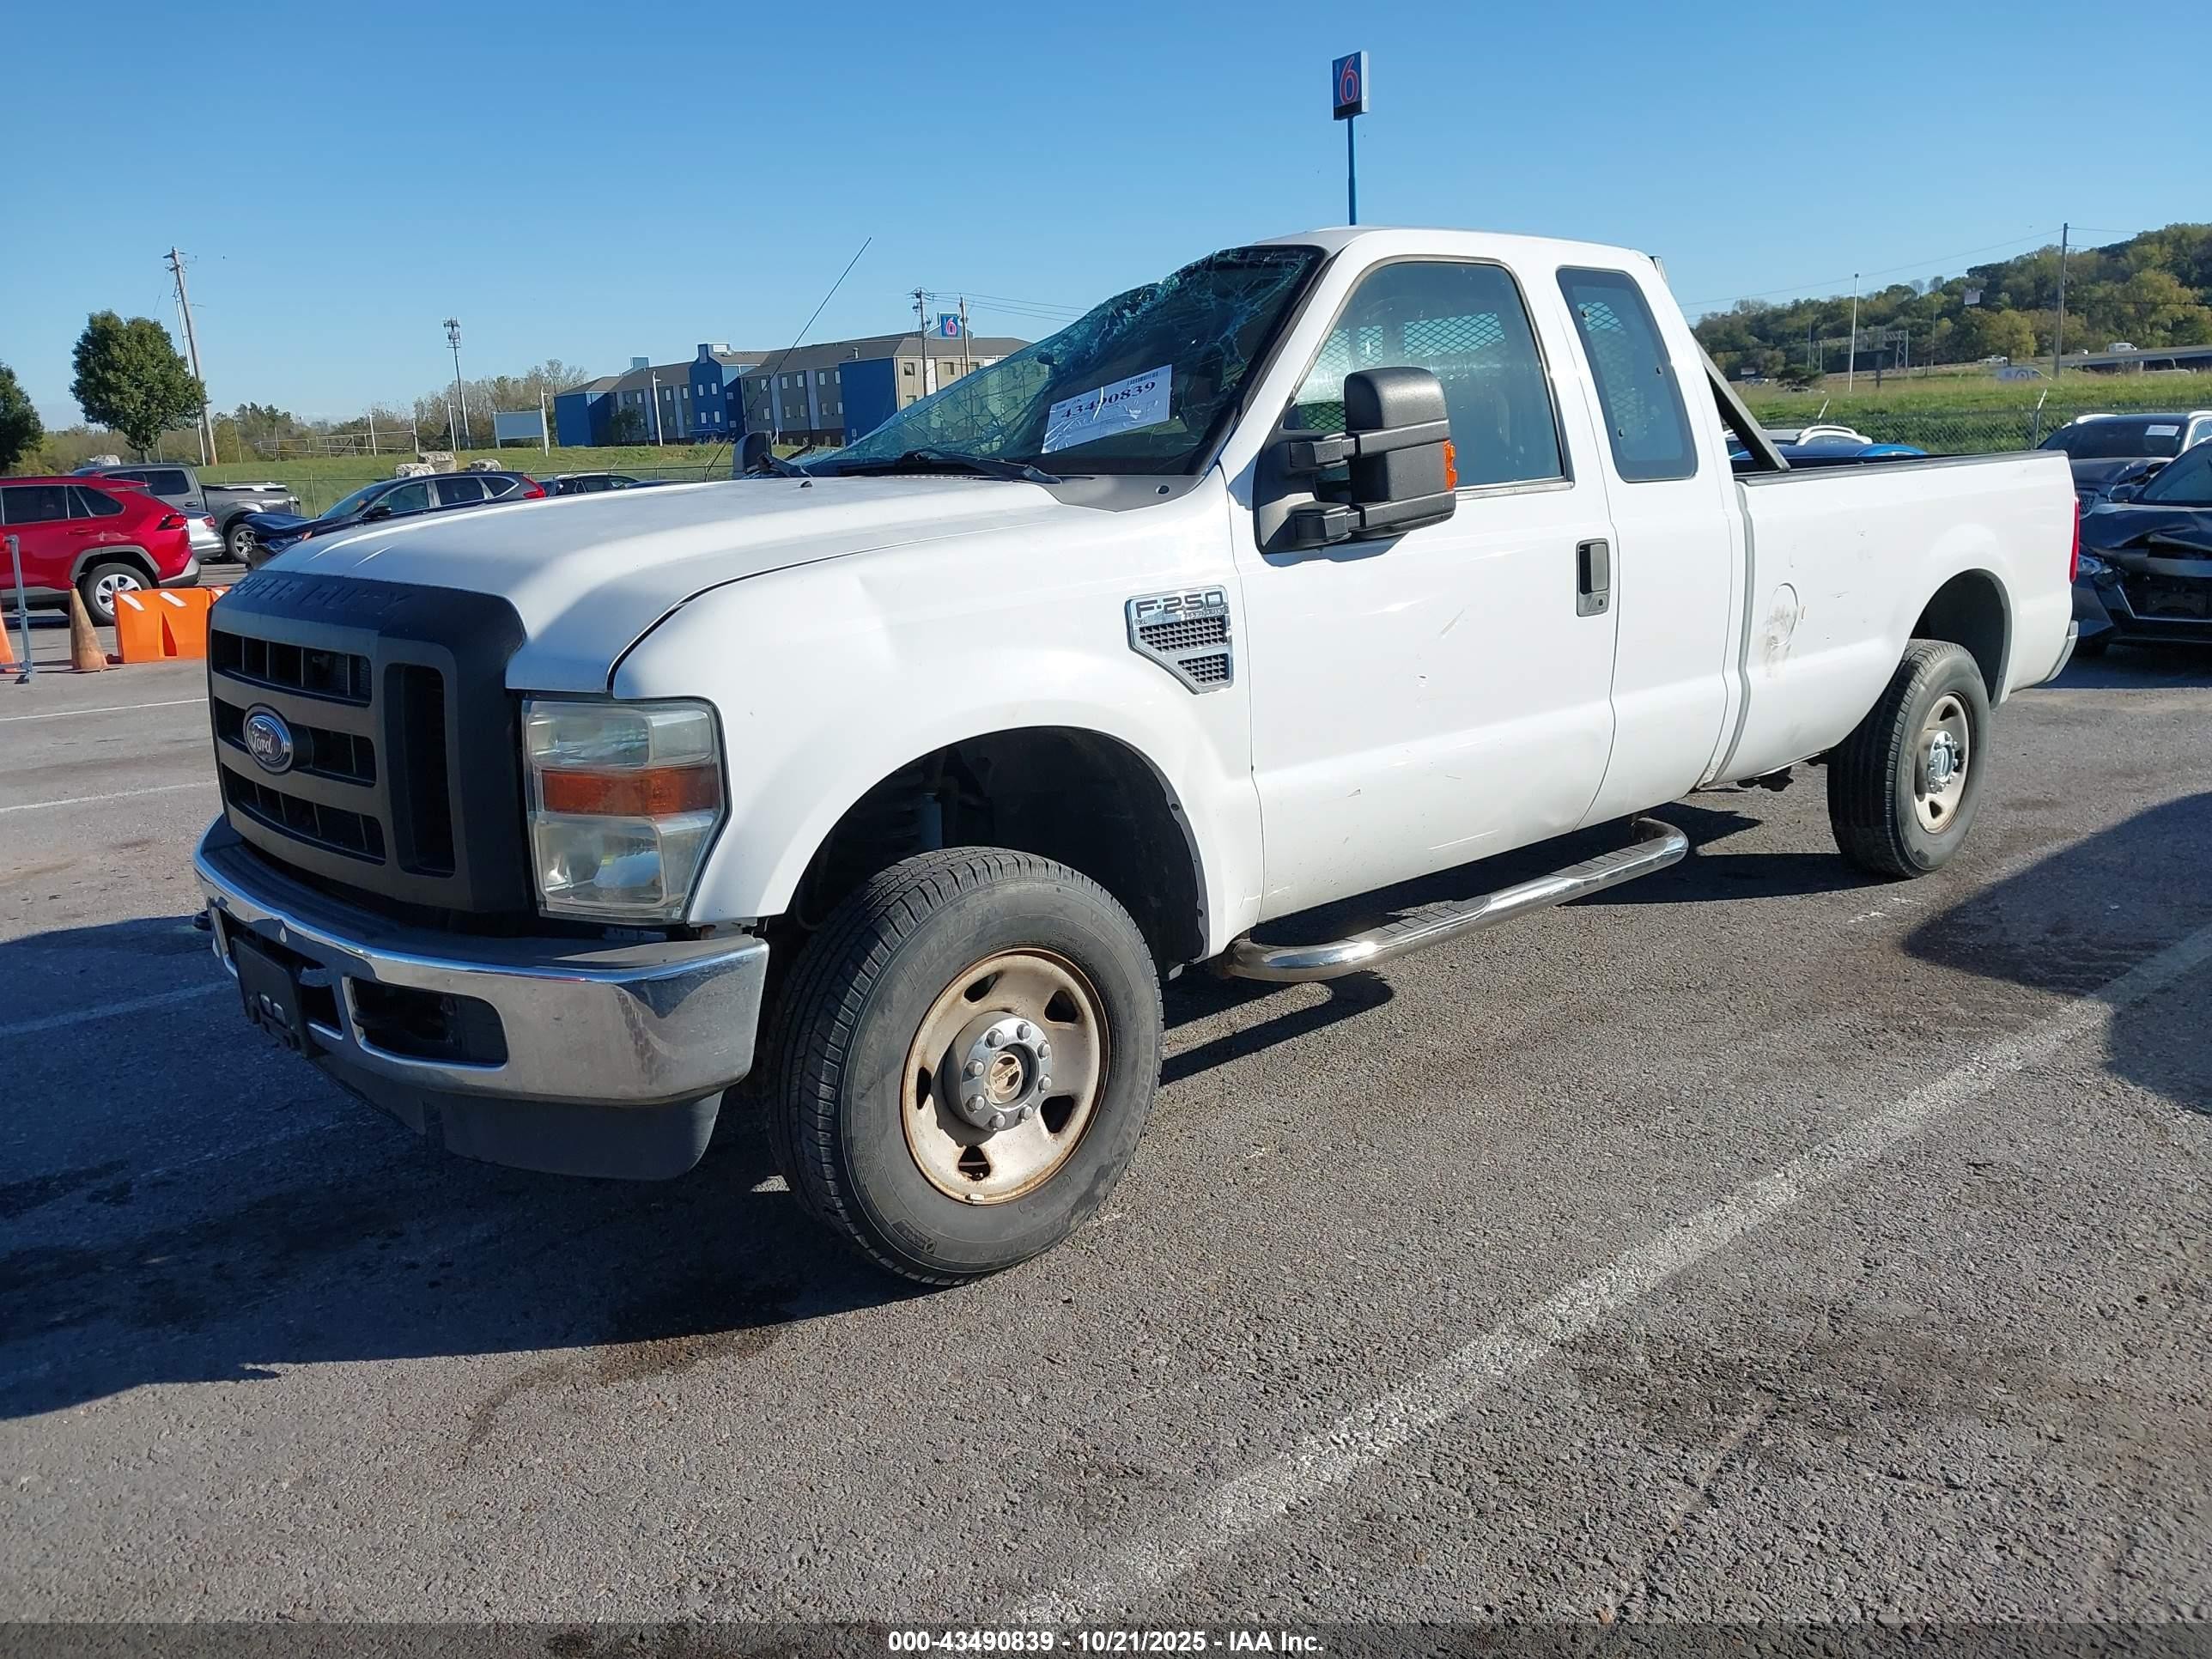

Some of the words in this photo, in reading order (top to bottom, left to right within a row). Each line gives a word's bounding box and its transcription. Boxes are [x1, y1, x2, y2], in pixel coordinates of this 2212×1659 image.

[1340, 55, 1359, 104] 6
[945, 317, 957, 336] 6
[1135, 590, 1224, 619] F-250
[250, 722, 274, 755] Ford
